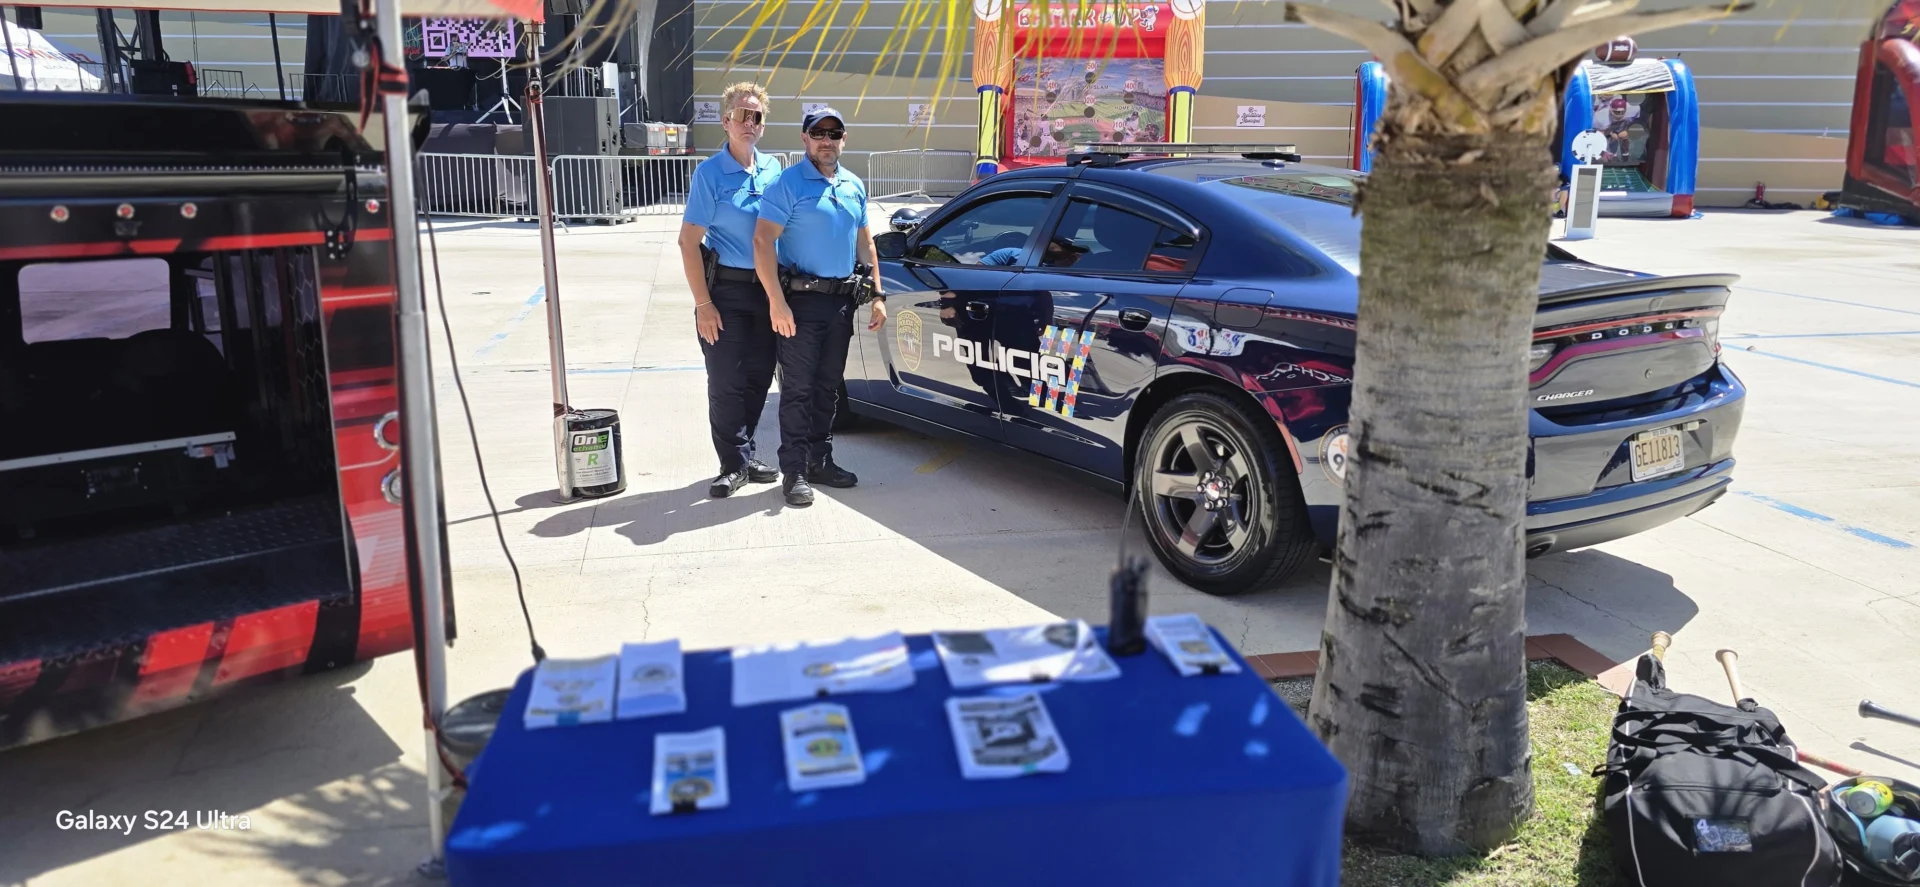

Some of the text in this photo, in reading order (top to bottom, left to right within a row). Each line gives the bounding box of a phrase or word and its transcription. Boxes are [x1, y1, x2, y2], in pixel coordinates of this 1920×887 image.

[1591, 321, 1692, 339] DODGE
[933, 332, 1066, 386] POLICIA
[1536, 389, 1594, 402] CHARGER
[574, 434, 608, 446] One
[573, 443, 607, 452] ethanol
[1635, 434, 1680, 468] GE11813
[587, 453, 599, 466] R
